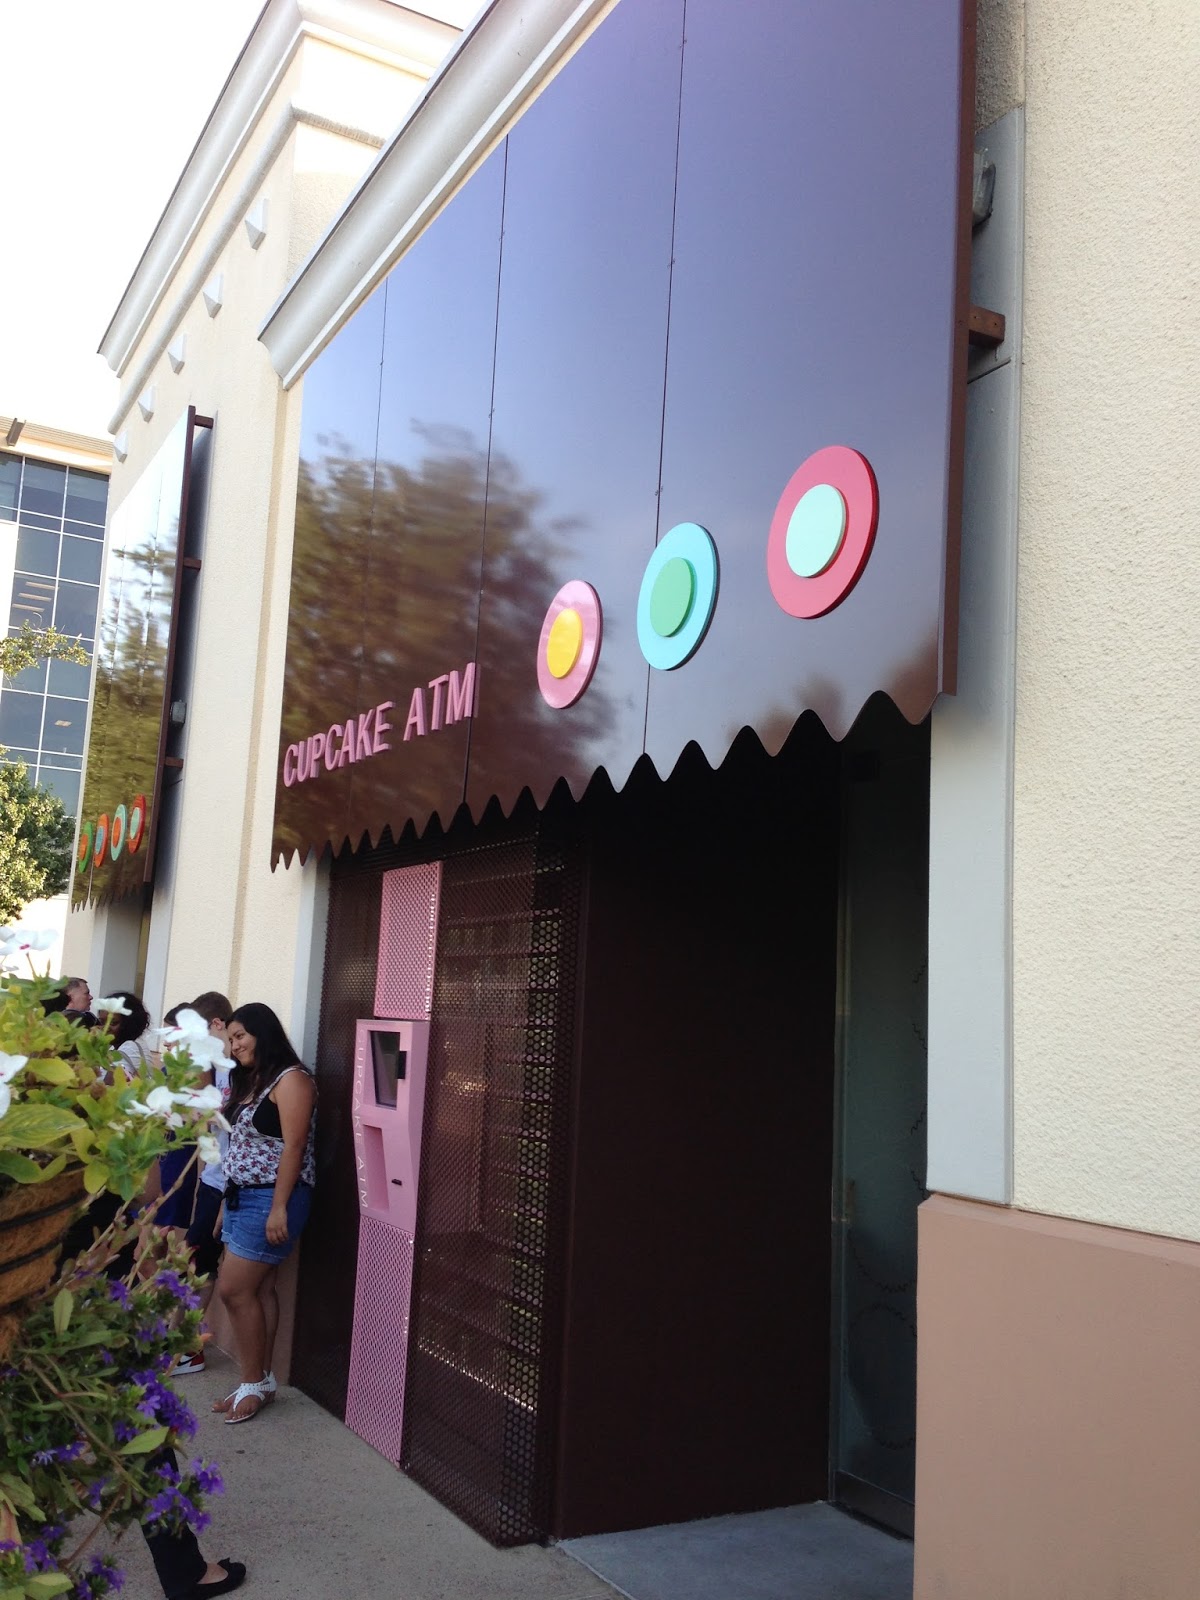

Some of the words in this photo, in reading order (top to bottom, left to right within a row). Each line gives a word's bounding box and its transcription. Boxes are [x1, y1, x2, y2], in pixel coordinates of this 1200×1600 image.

[283, 701, 395, 787] CUPCAKE
[403, 662, 477, 741] ATM
[354, 1029, 365, 1145] CUPCAKE
[357, 1156, 369, 1208] ATM
